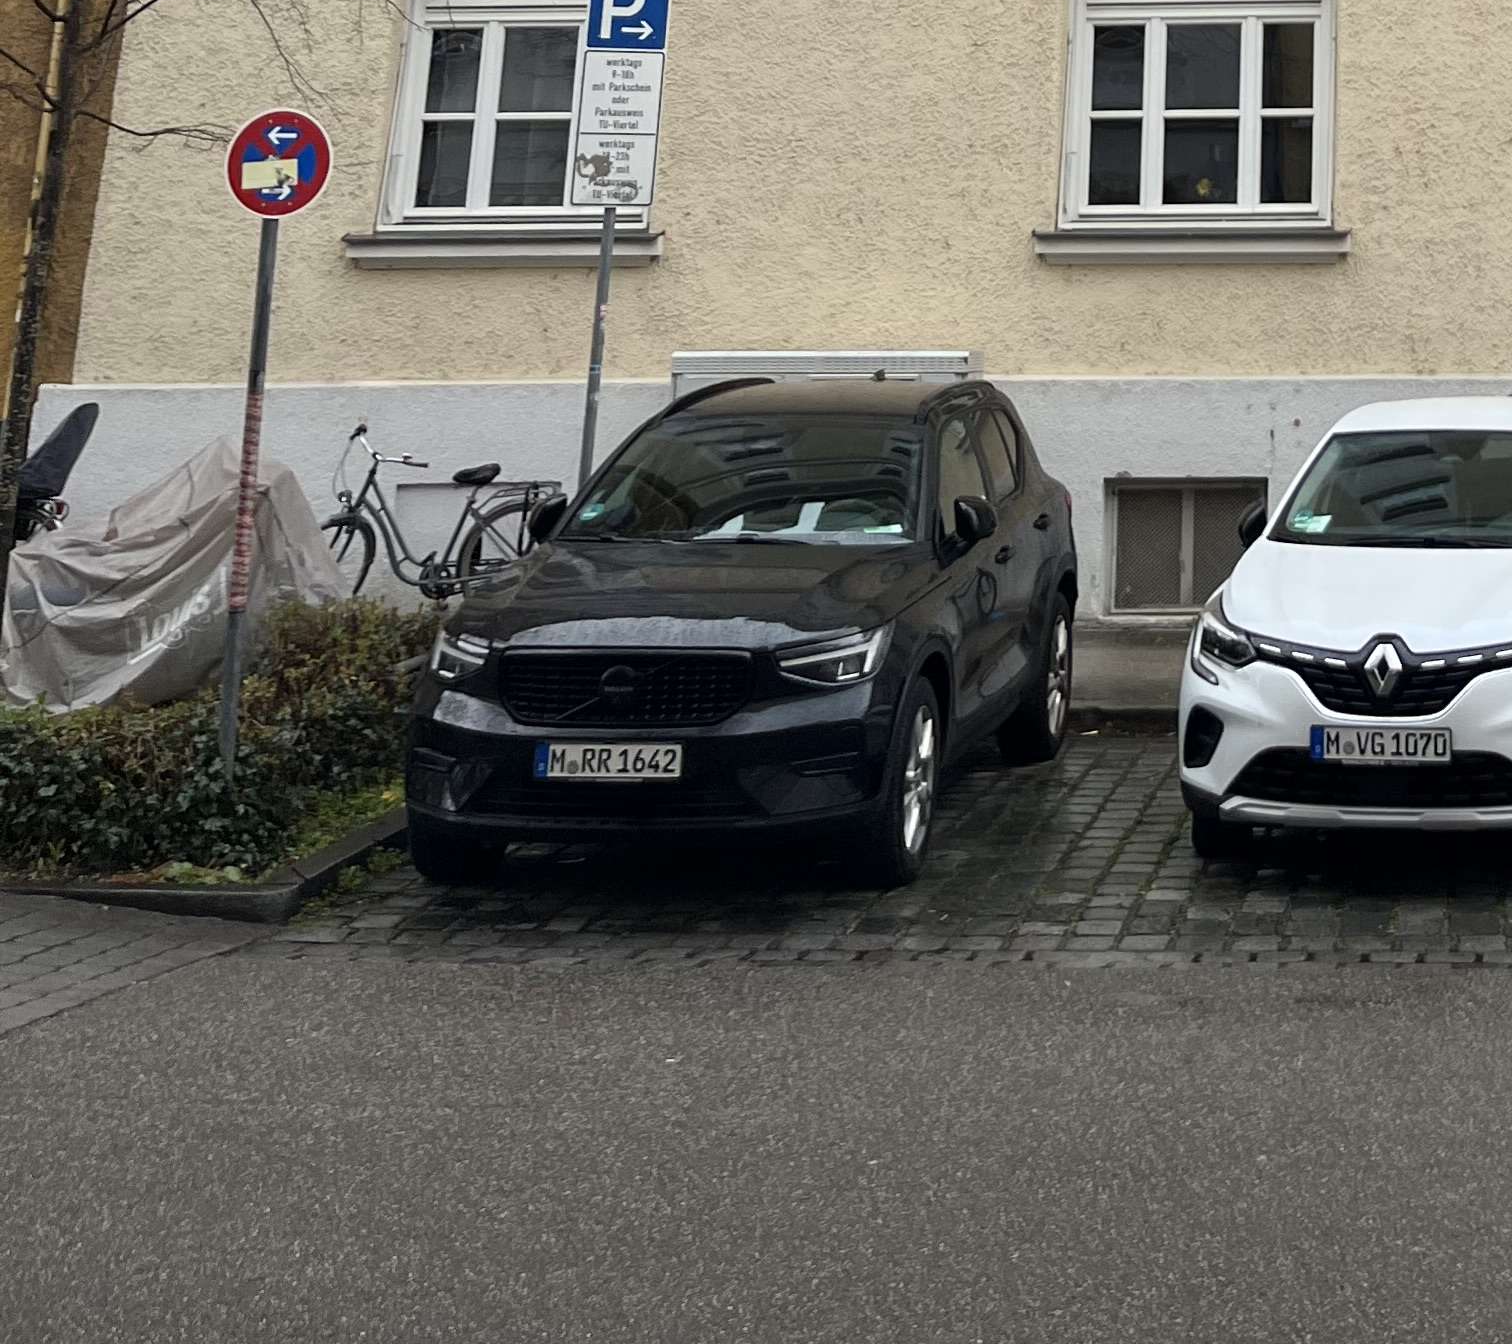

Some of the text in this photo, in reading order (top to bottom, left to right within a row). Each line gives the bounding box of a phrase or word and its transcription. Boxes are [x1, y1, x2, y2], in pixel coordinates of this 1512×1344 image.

[592, 83, 606, 91] mit
[611, 95, 629, 104] oder
[1326, 731, 1340, 755] M
[1356, 731, 1385, 756] VG
[1390, 732, 1447, 757] 1070
[550, 748, 677, 773] M RR 1642
